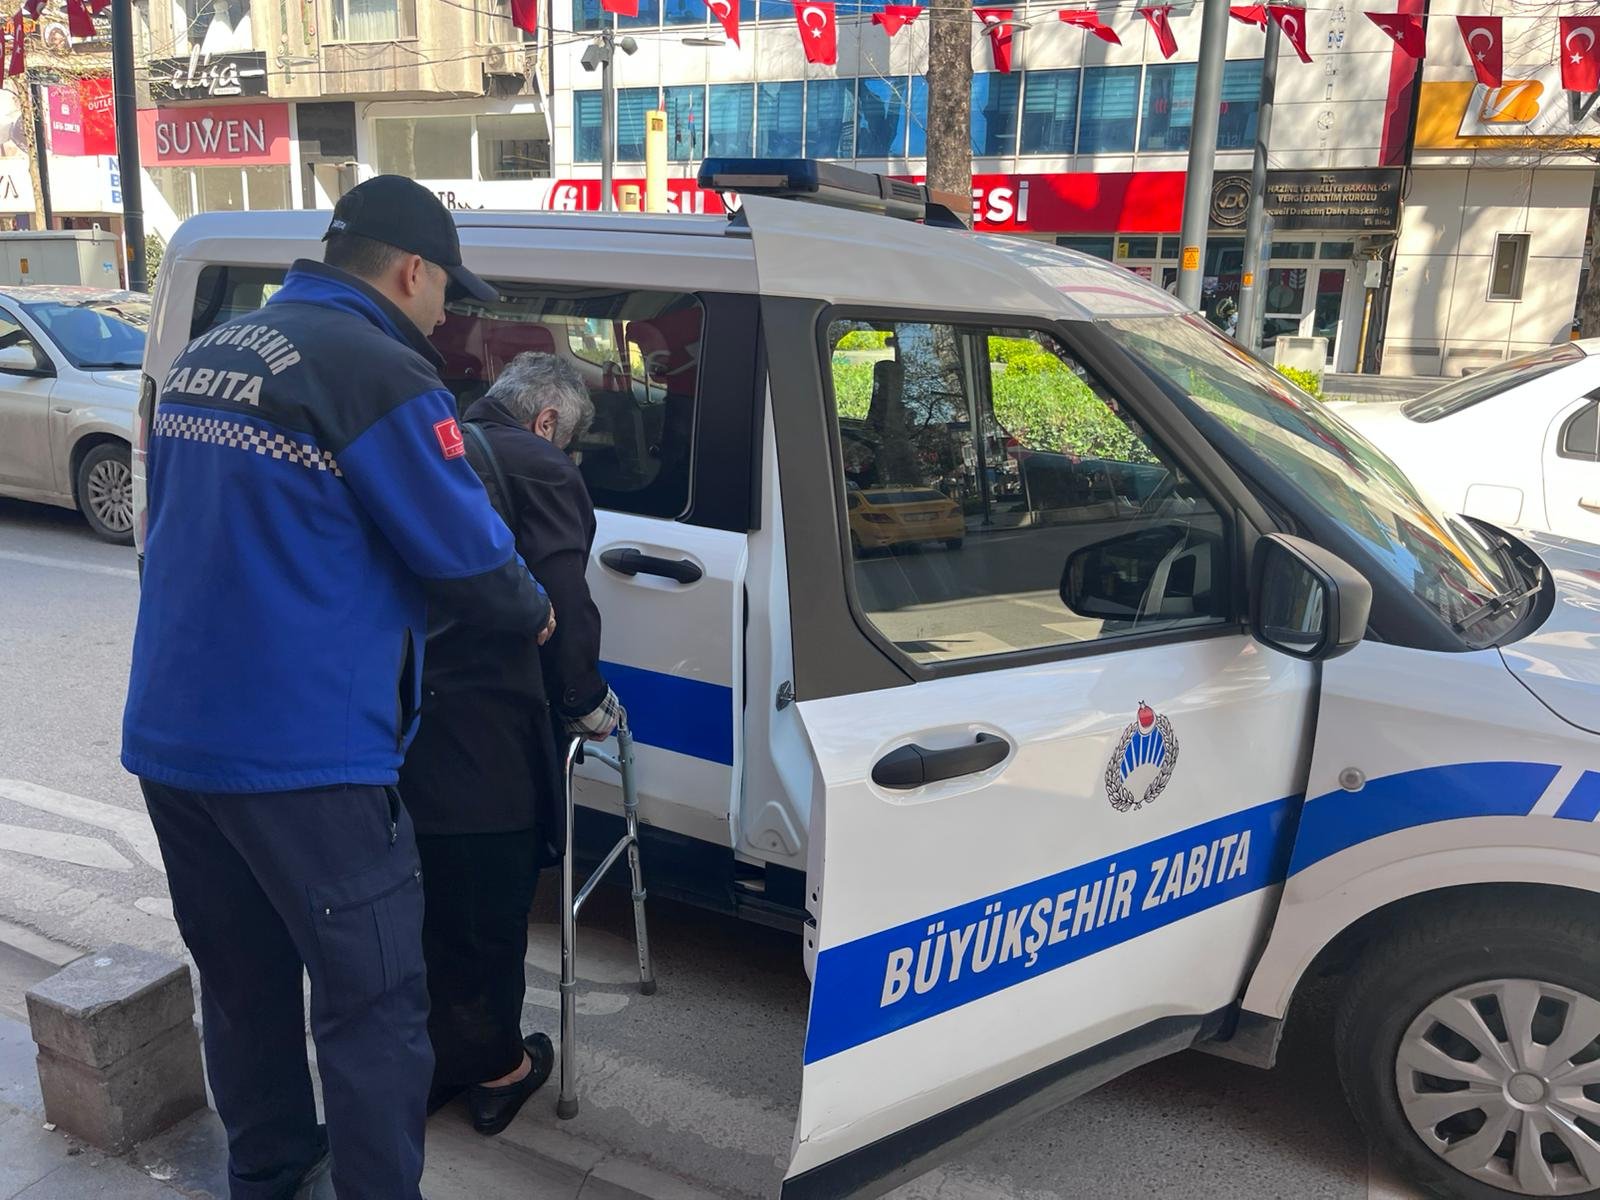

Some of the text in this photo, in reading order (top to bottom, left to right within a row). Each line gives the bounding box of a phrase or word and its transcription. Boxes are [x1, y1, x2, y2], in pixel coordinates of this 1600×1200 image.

[88, 97, 113, 110] OUTLE
[157, 118, 265, 154] SUWEN
[1267, 184, 1297, 193] HAZİNE
[1300, 184, 1310, 193] VE
[1312, 183, 1343, 193] MALİYE
[1304, 193, 1341, 202] DENETİM
[1342, 193, 1377, 202] KURULU
[174, 325, 301, 376] ÜYÜKŞEHİR
[162, 367, 263, 407] ZABITA
[880, 830, 1251, 1008] BÜYÜKŞEHİR ZABITA
